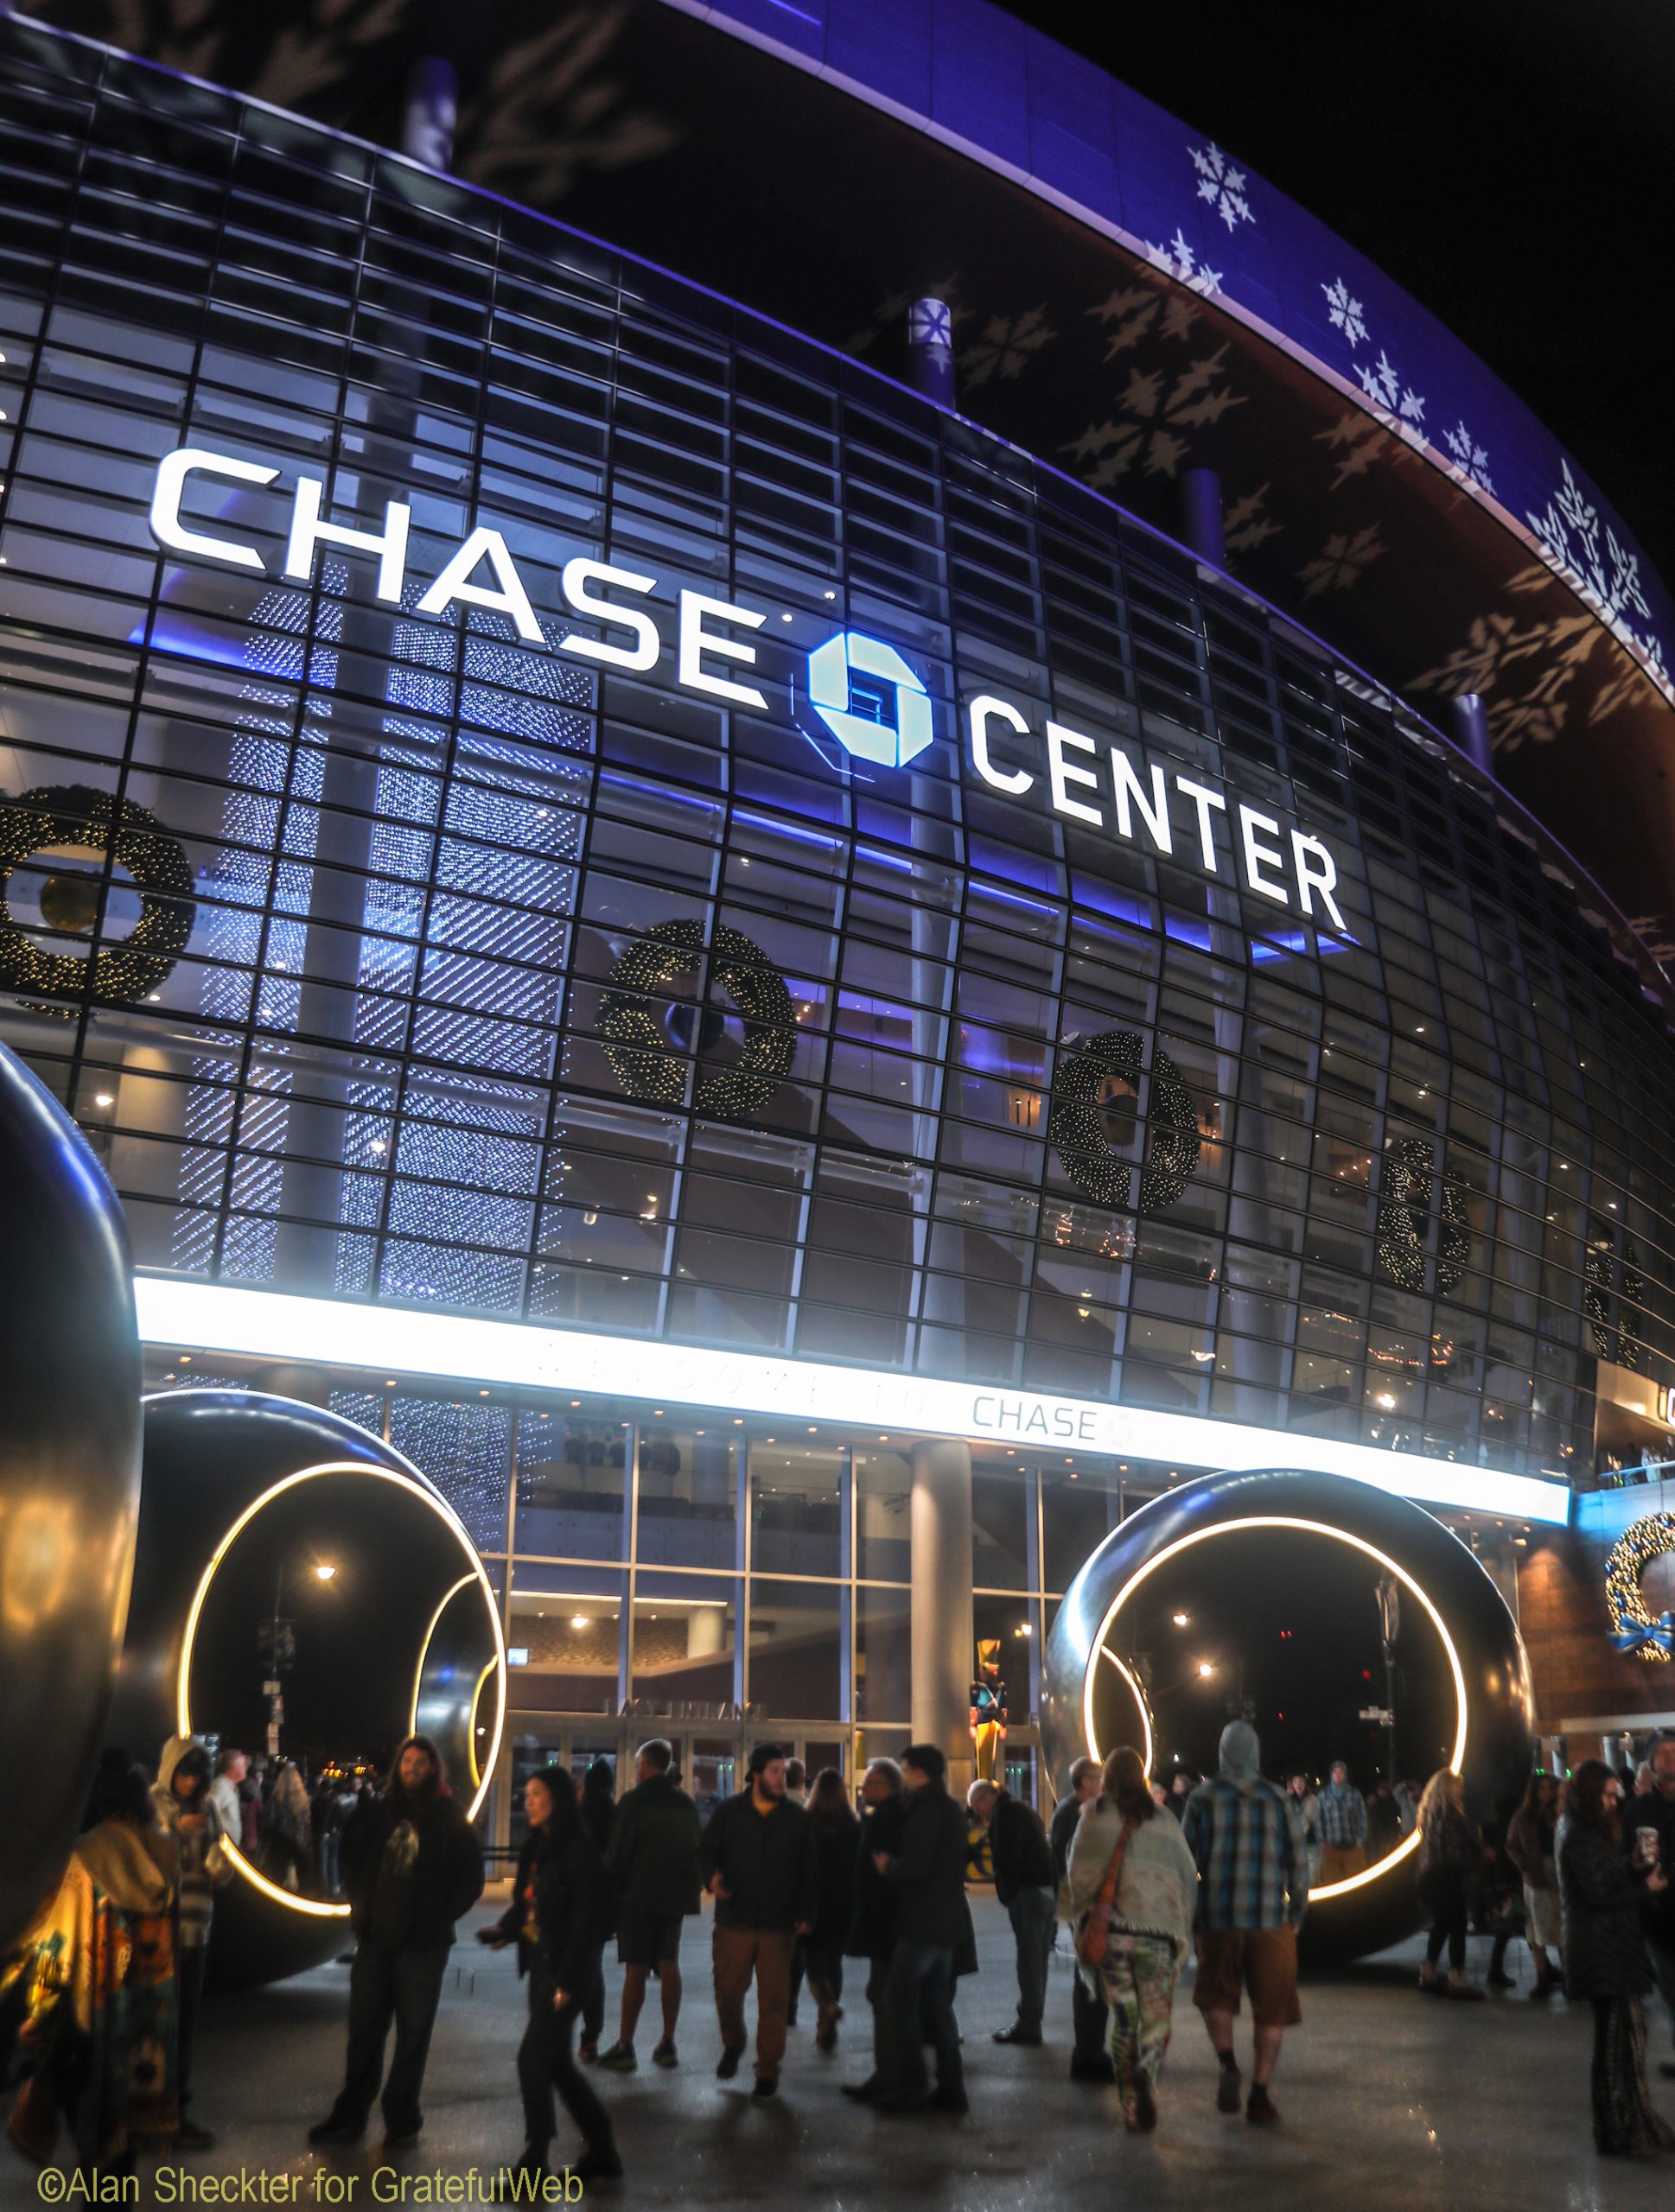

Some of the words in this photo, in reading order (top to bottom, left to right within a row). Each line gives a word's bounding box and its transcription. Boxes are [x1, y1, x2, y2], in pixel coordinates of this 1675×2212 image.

[150, 448, 770, 710] CHASE
[969, 694, 1348, 931] CENTER
[972, 1395, 1099, 1440] CHASE
